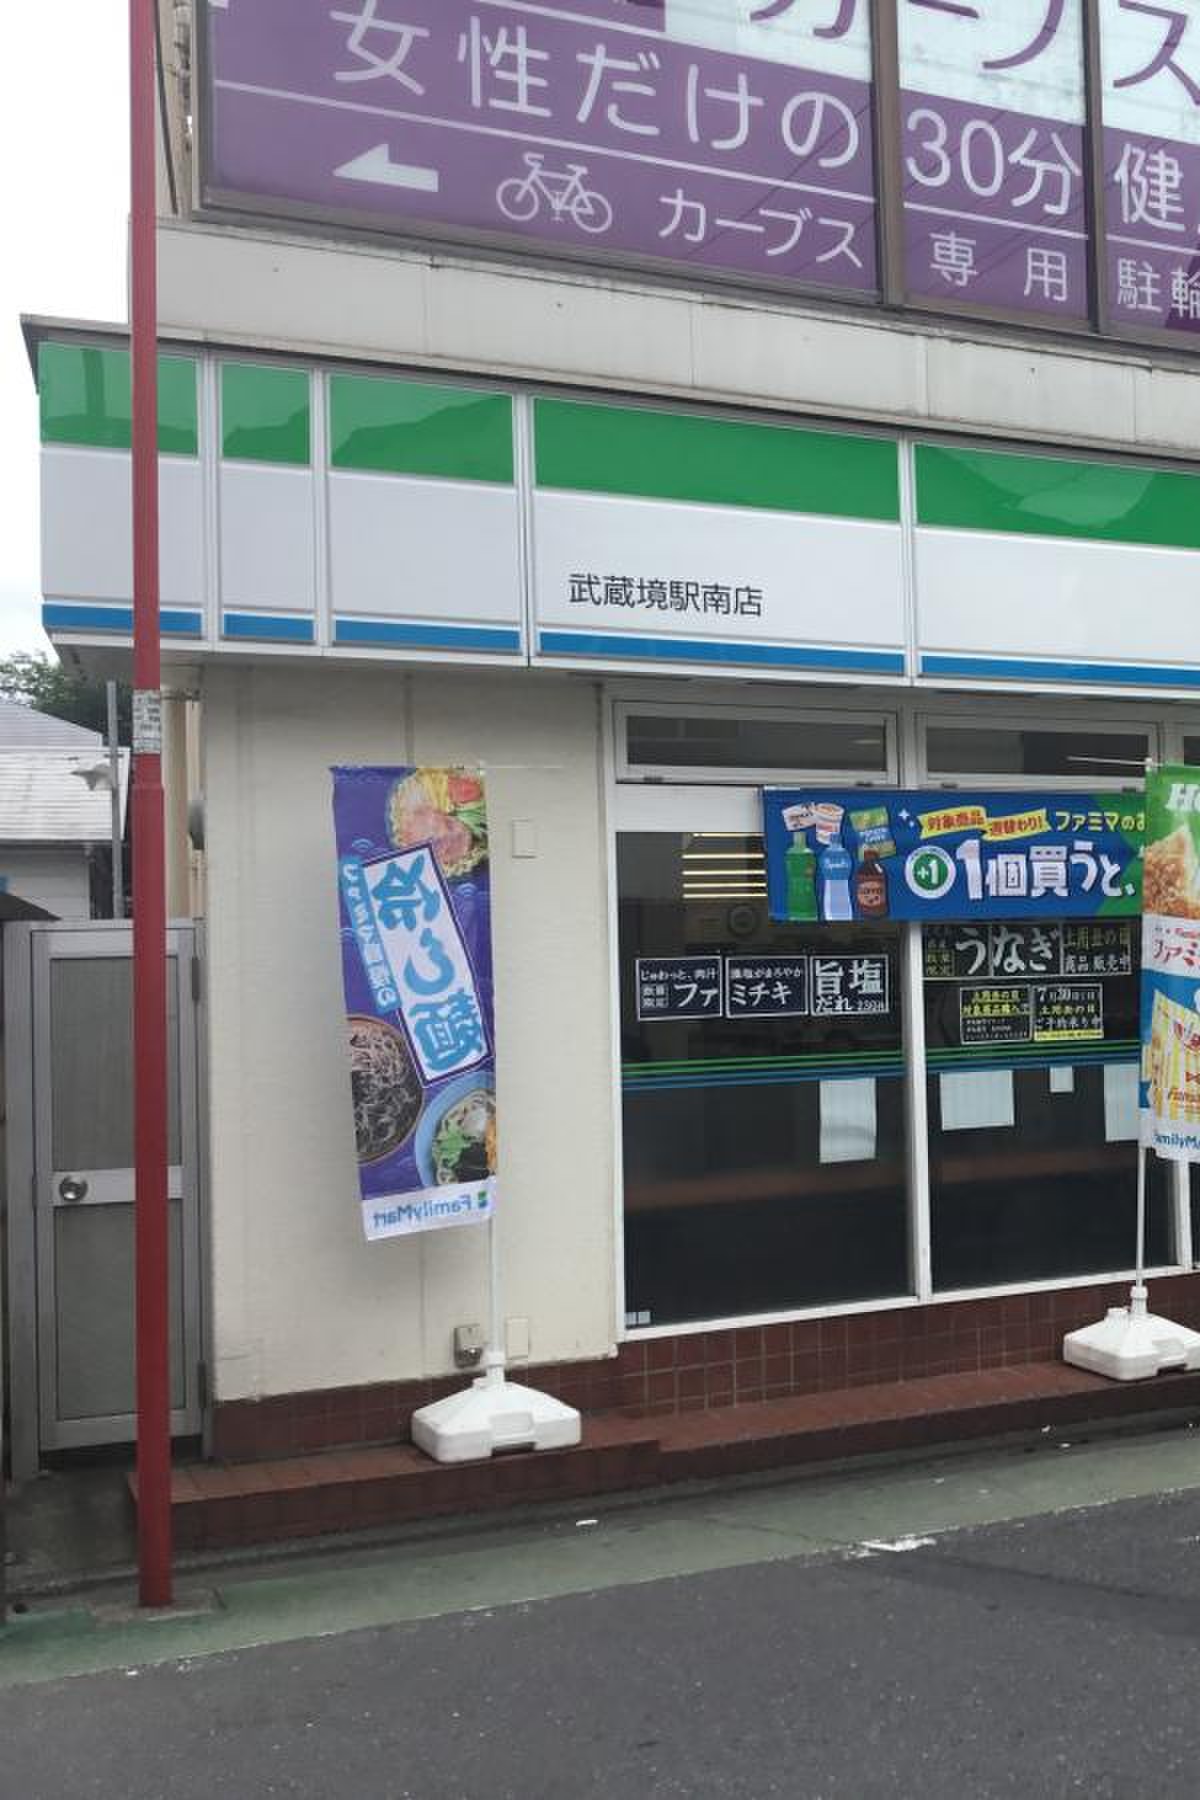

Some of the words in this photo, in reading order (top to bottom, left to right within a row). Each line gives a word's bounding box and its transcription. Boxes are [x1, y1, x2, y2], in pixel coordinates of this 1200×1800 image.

[330, 0, 860, 168] 女性だけの
[906, 109, 1082, 216] 30分
[657, 188, 863, 268] カーブス
[929, 231, 1068, 302] 専用
[568, 572, 764, 618] 武蔵境駅南店
[955, 927, 1060, 975] うなぎ
[731, 981, 792, 1007] ミチキ
[815, 960, 884, 994] 旨塩
